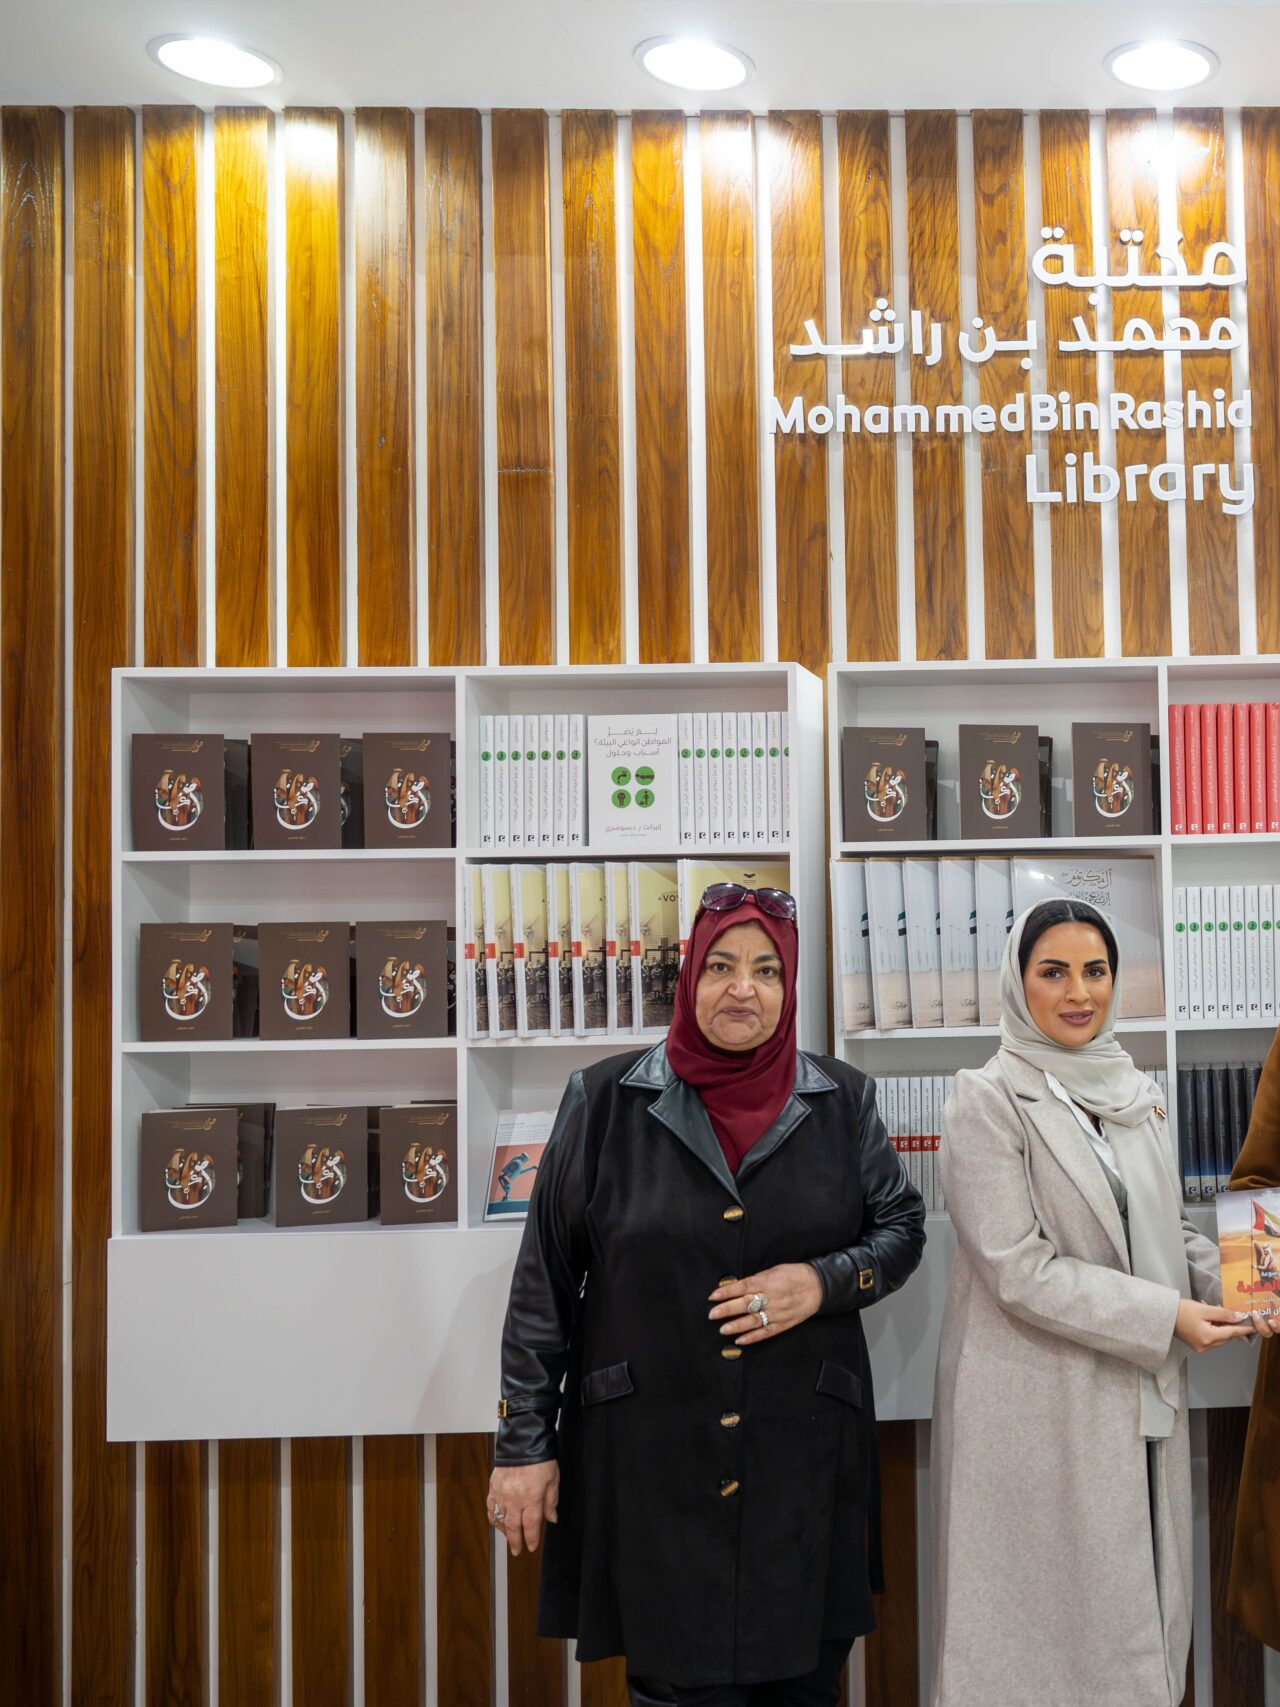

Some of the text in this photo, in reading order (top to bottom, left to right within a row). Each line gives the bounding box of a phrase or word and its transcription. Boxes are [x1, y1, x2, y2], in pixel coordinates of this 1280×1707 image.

[1031, 226, 1247, 306] مكتبة
[789, 298, 1242, 370] محمد بن راشد
[768, 388, 1252, 435] Mohammed Bin Rashid
[1025, 452, 1255, 515] Library
